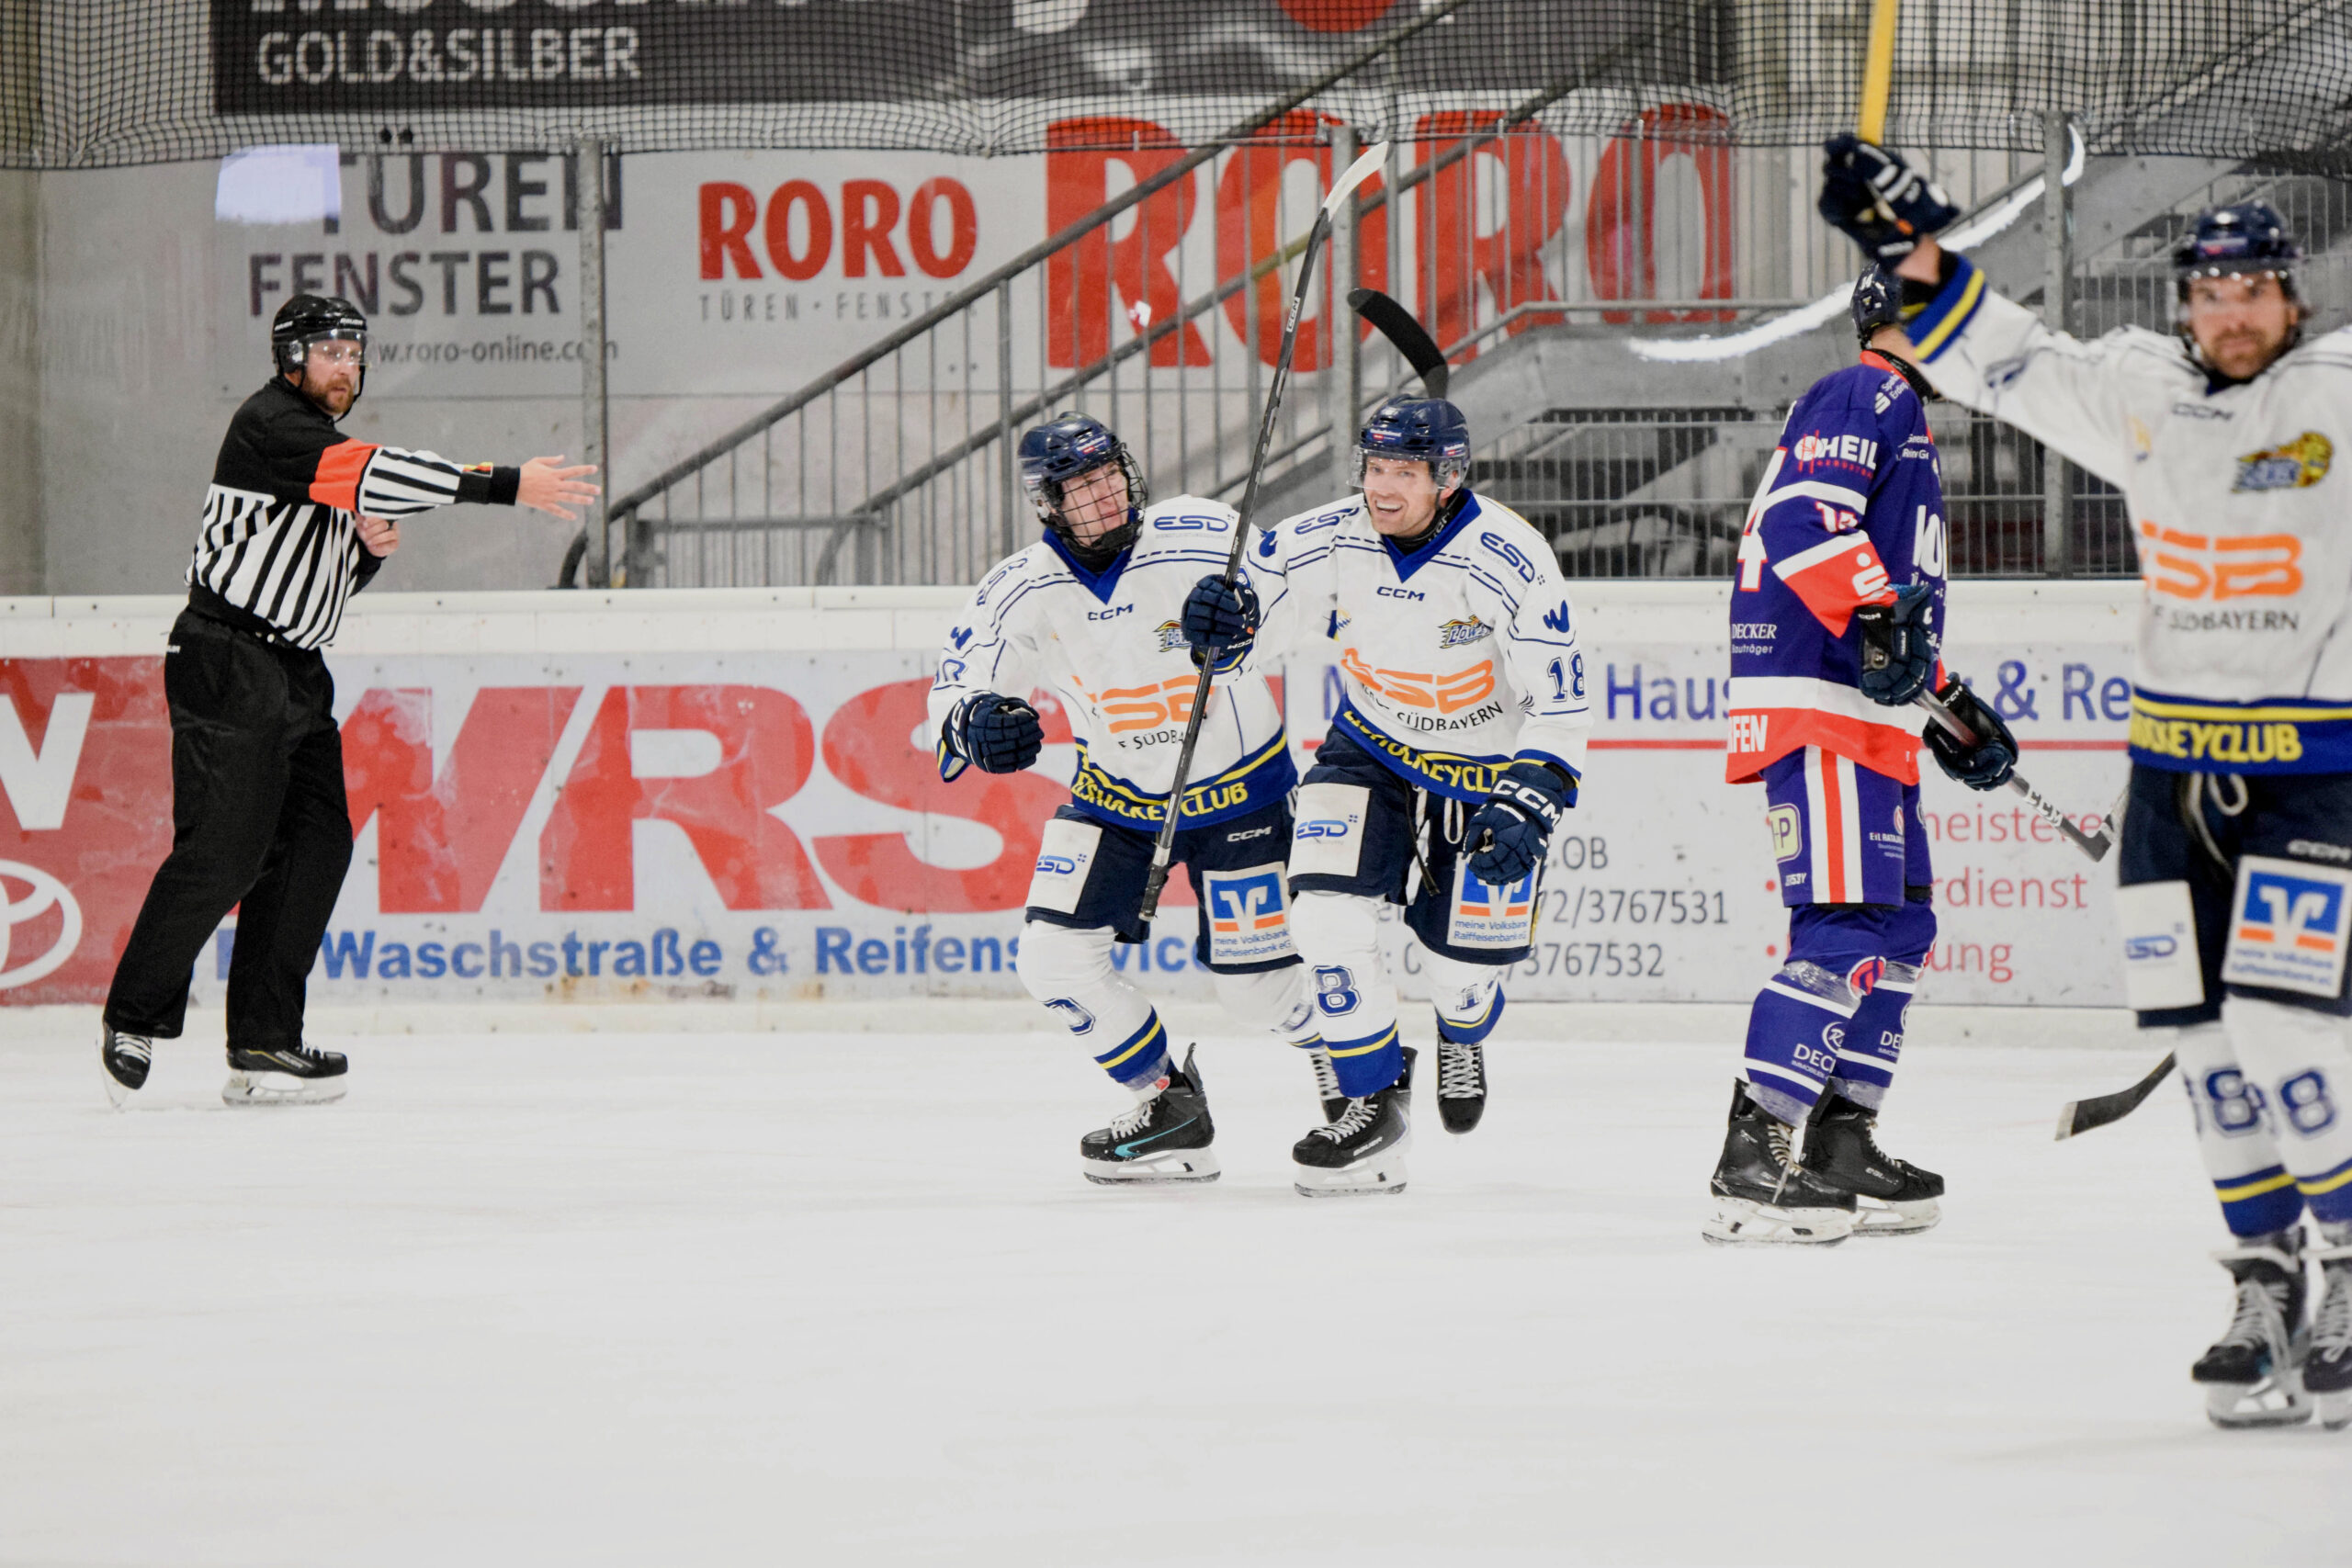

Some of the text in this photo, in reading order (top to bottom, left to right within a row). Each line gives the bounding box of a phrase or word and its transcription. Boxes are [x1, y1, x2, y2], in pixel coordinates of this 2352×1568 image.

[257, 26, 642, 85] GOLD&SILBER
[323, 128, 623, 235] ÜREN
[698, 175, 978, 281] RORO
[1046, 99, 1741, 372] RORO
[250, 249, 561, 317] FENSTER
[698, 288, 978, 321] TÜREN FENST
[1154, 514, 1229, 533] ESD
[1480, 530, 1536, 584] ESD
[1087, 603, 1135, 622] CCM
[1376, 585, 1426, 603] CCM
[1731, 622, 1778, 641] DECKER
[1546, 649, 1587, 704] 18
[1606, 663, 1730, 721] Hau
[2062, 662, 2132, 722] Re
[1396, 700, 1504, 731] SÜDBAYERN
[1492, 779, 1561, 827] CCM
[1226, 826, 1272, 843] CCM
[1295, 818, 1349, 840] ESD
[1540, 886, 1729, 930] 72/3767531
[1931, 867, 2088, 908] rdienst
[322, 928, 722, 980] Waschstraße
[746, 926, 788, 977] &
